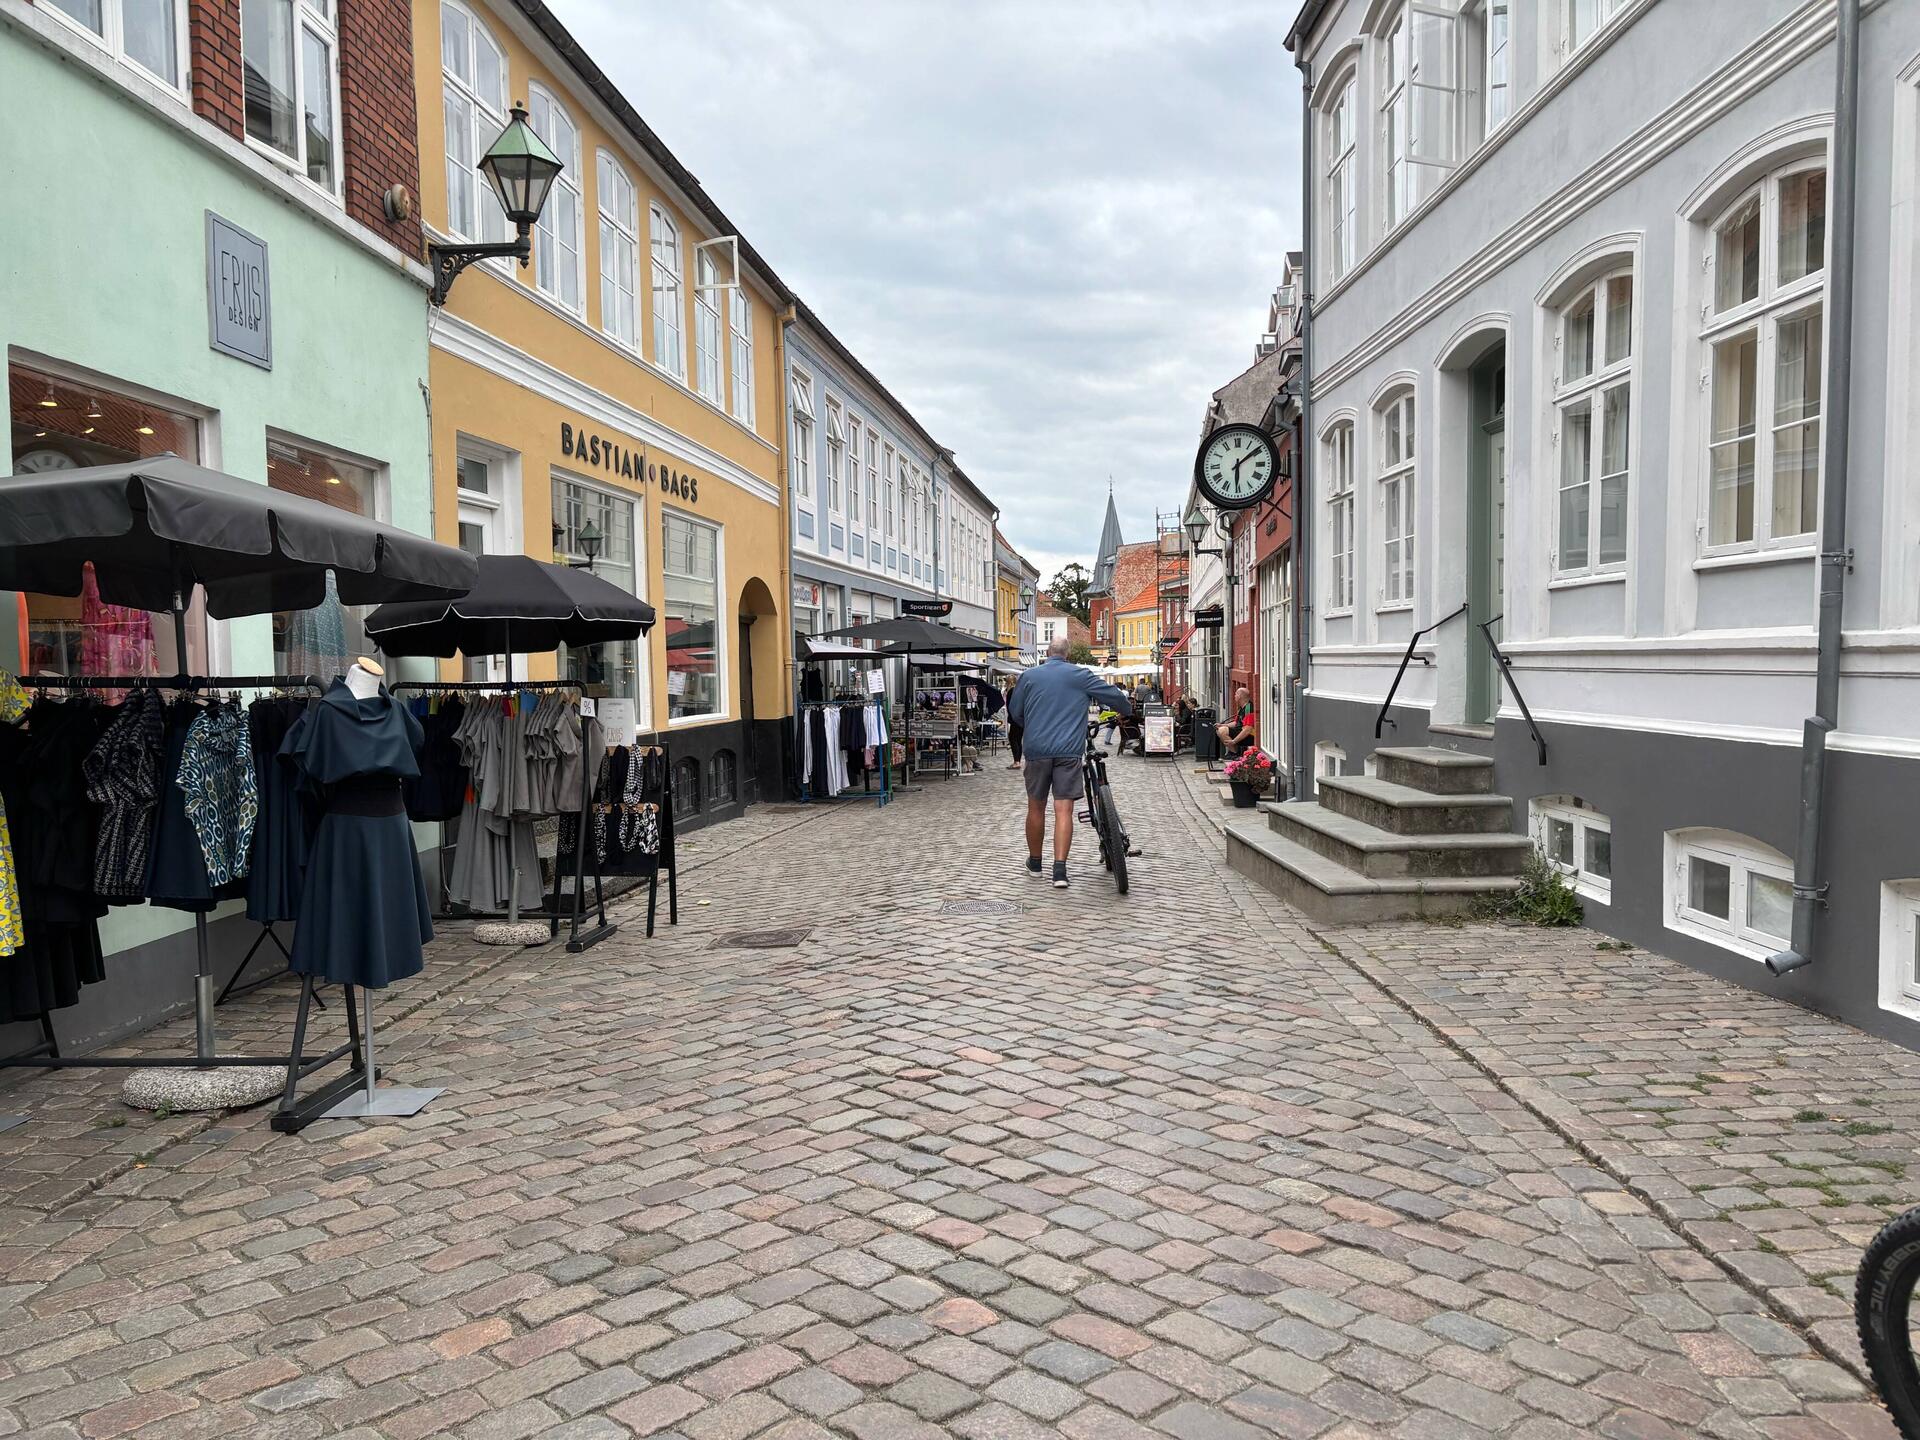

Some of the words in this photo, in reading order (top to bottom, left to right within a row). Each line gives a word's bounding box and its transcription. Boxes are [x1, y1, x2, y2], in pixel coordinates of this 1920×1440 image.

[221, 250, 262, 322] FRIIS
[228, 306, 259, 333] DESIGN
[561, 422, 645, 483] BASTIAN
[660, 464, 698, 504] BAGS
[1879, 1240, 1920, 1281] OBBY
